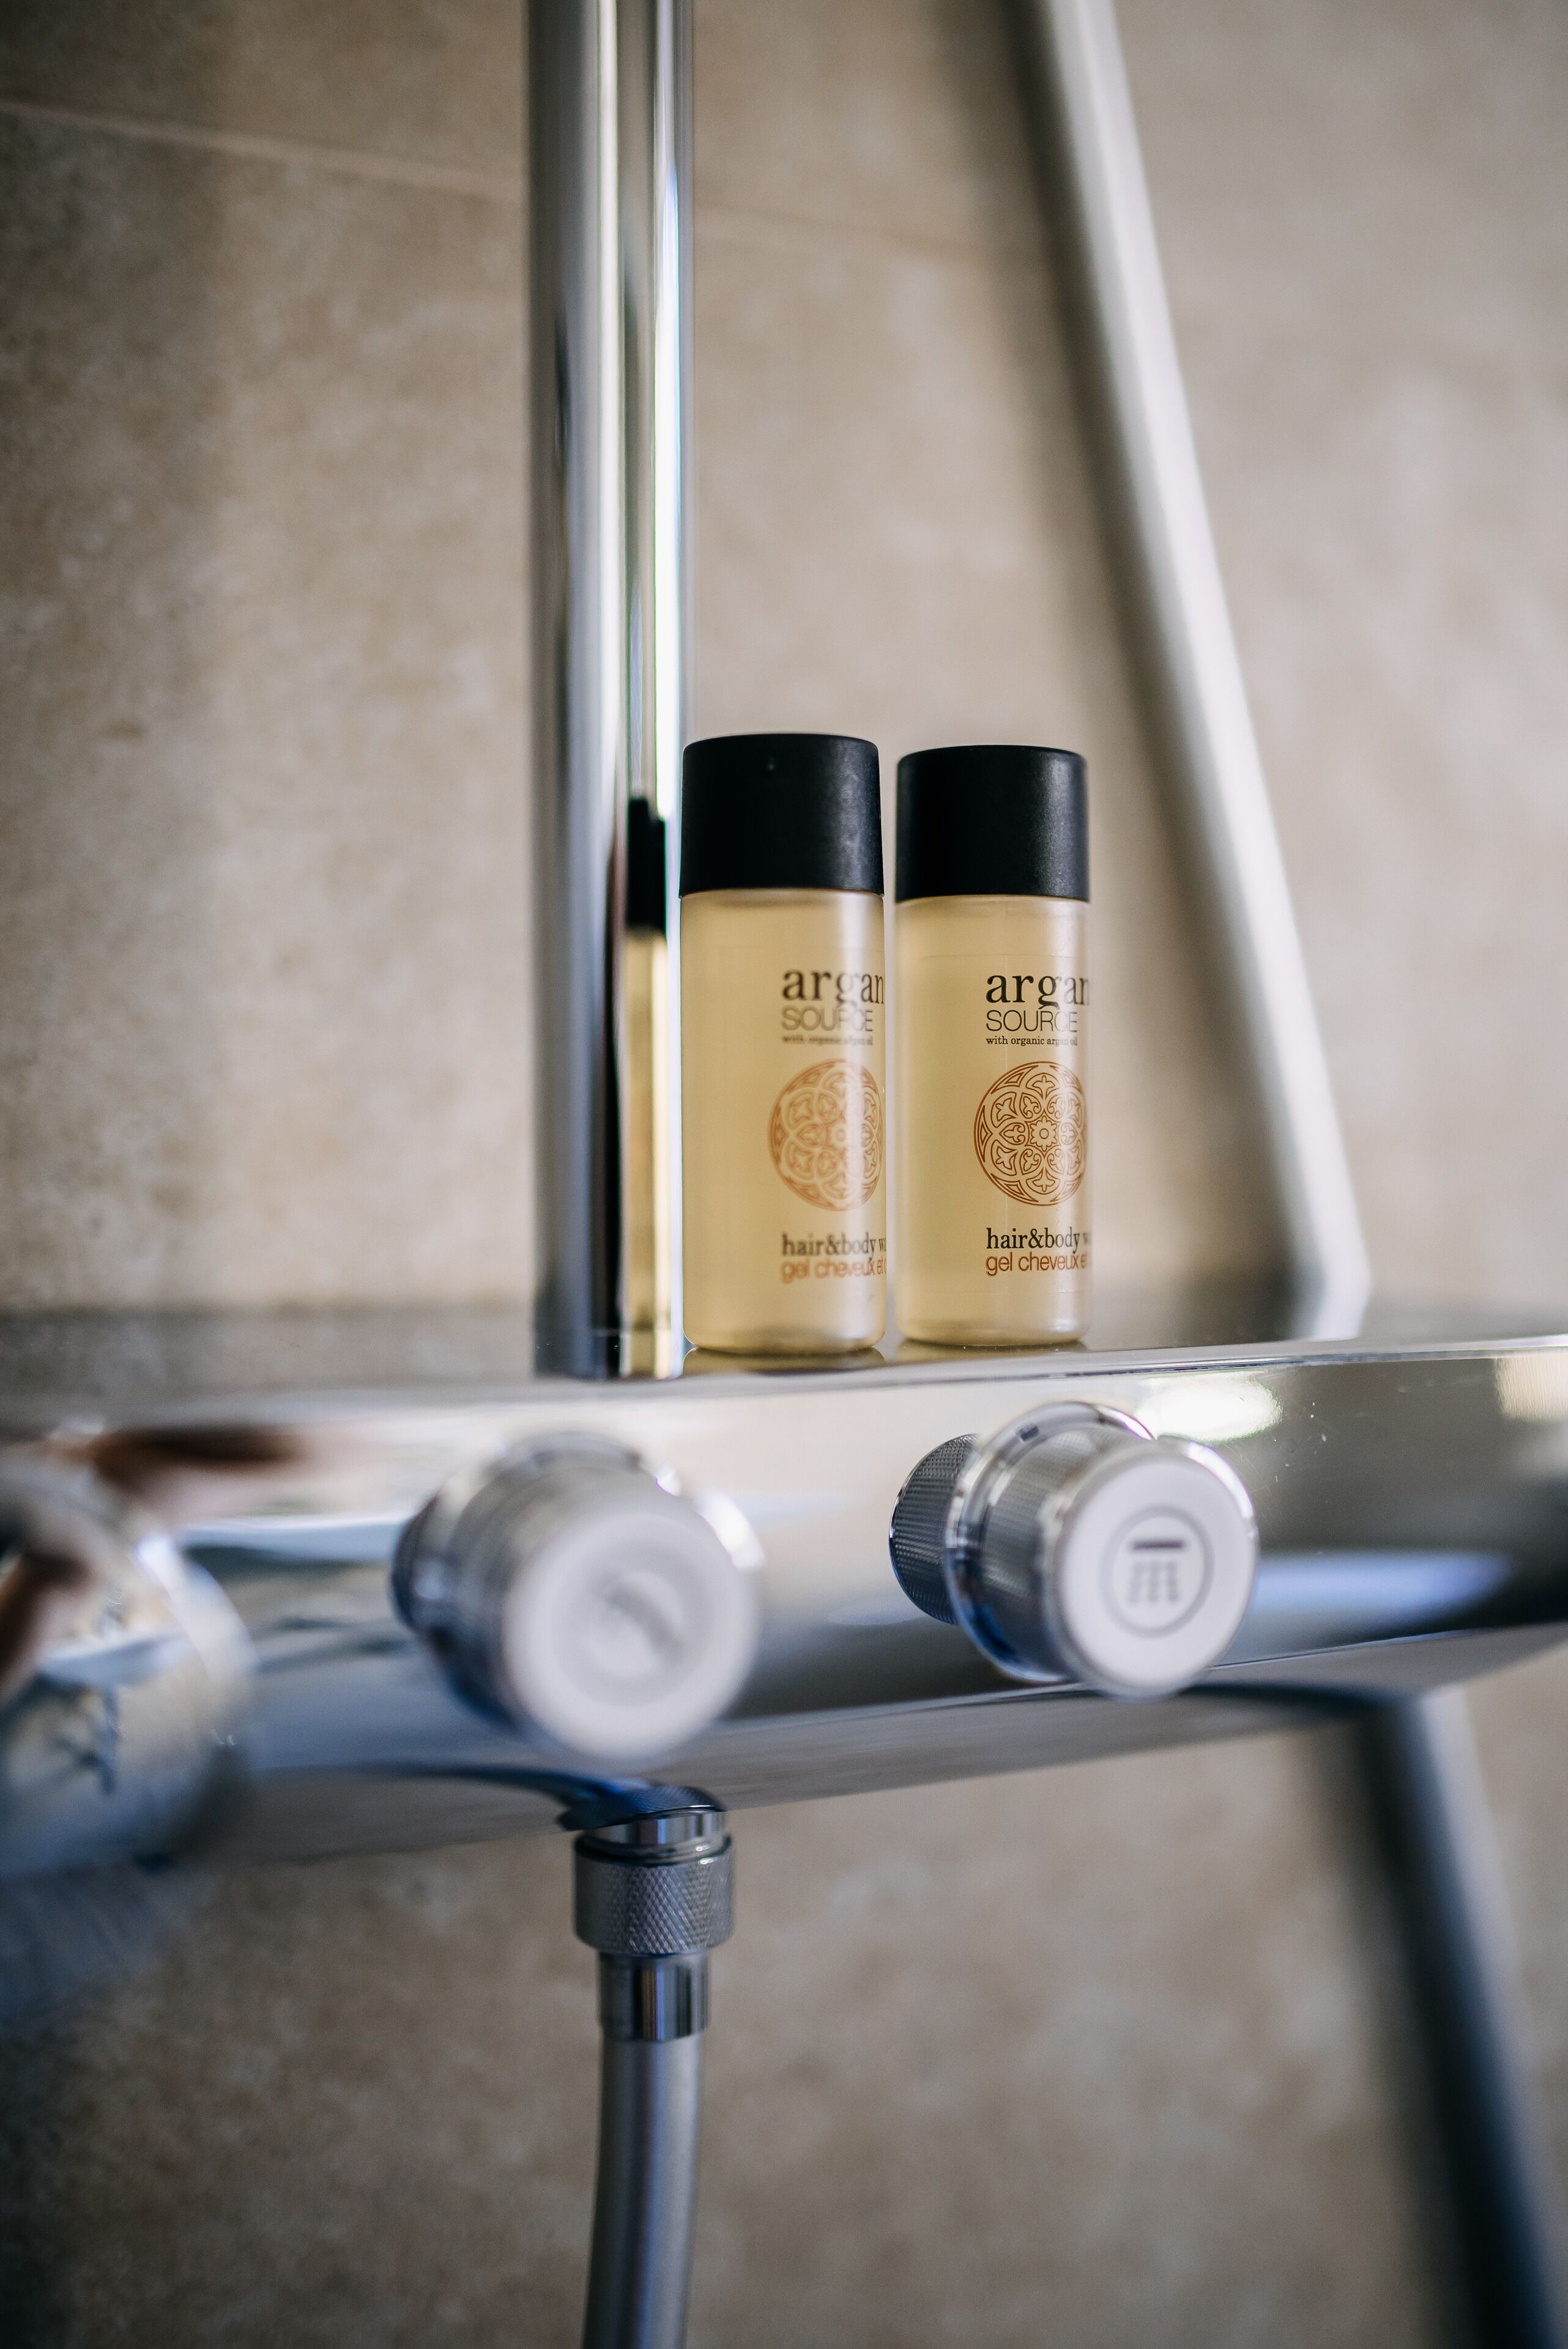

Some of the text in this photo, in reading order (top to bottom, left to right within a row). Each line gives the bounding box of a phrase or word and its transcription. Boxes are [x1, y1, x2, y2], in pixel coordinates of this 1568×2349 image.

[782, 970, 885, 1008] argan
[986, 1009, 1077, 1032] SOURCE
[986, 1035, 1008, 1045] with
[1011, 1036, 1044, 1047] organic
[986, 1226, 1080, 1254] hair&body
[781, 1258, 810, 1284] gel
[985, 1252, 1013, 1277] gel
[1018, 1252, 1079, 1272] cheveux
